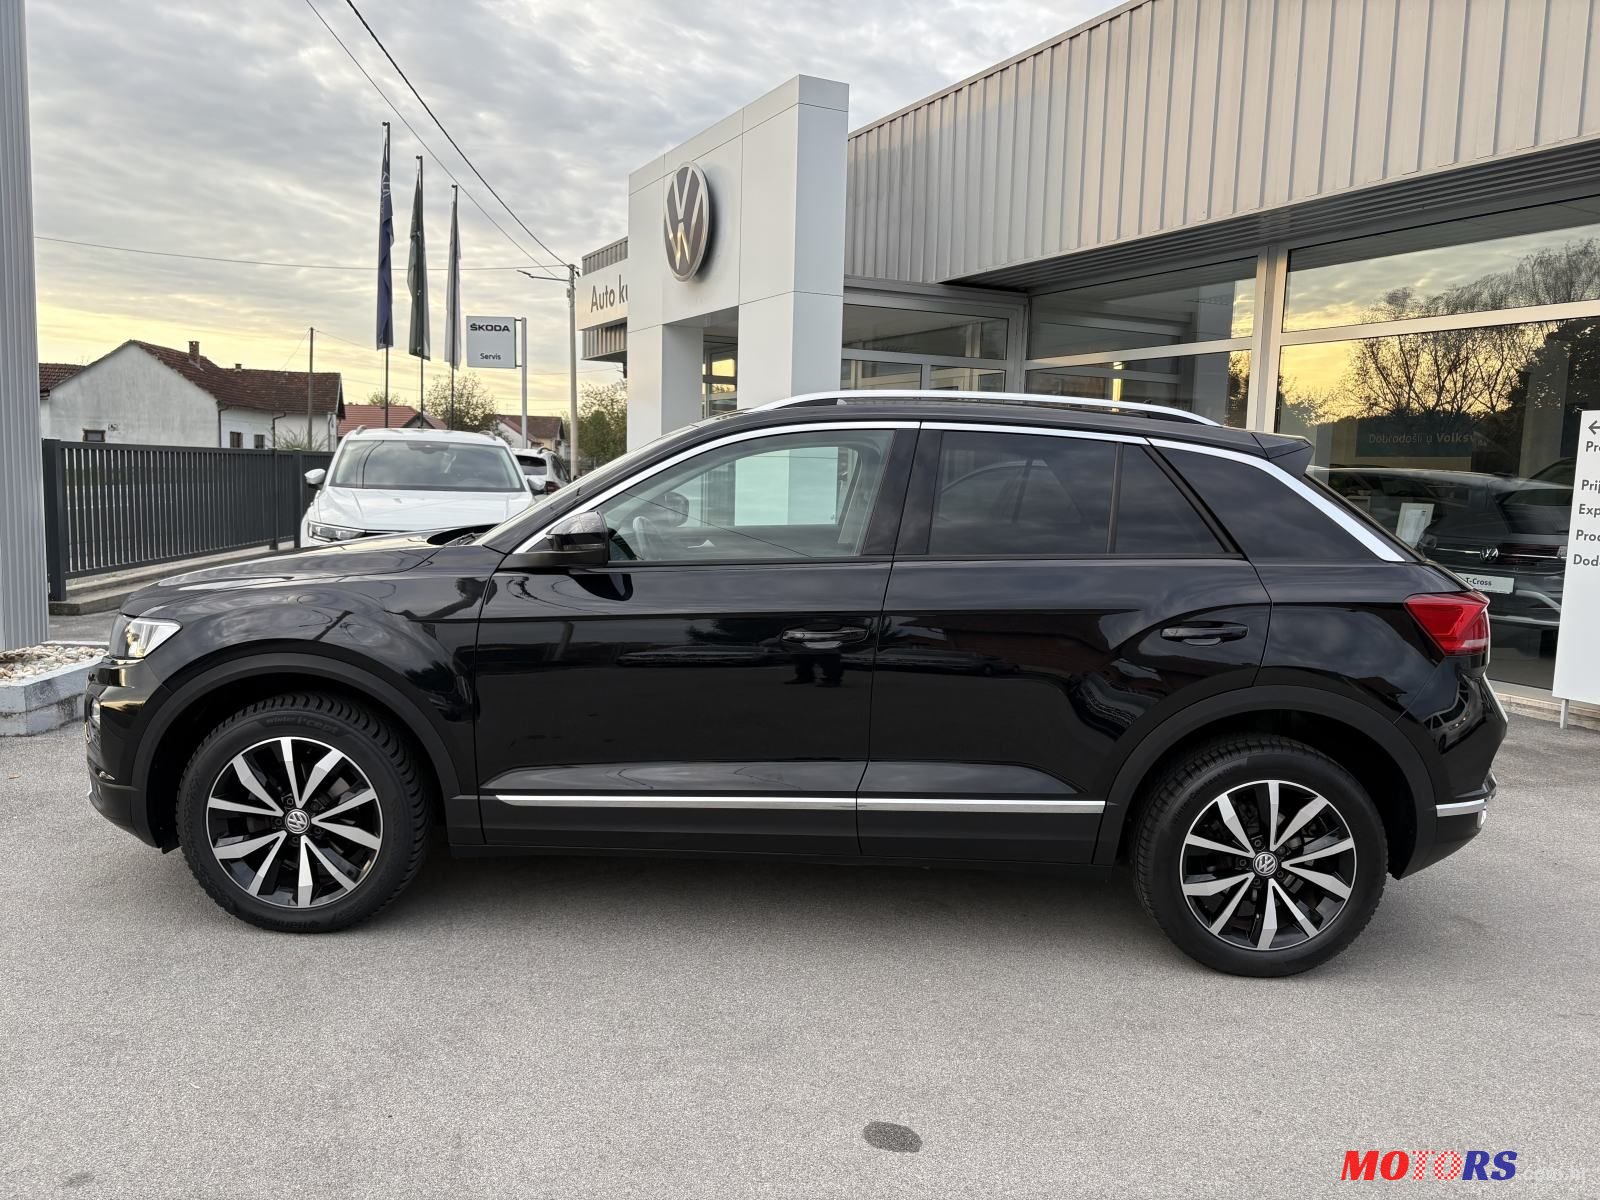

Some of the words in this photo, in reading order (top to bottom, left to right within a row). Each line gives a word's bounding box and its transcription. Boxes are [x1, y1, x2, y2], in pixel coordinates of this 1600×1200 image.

[590, 285, 615, 313] Auto
[470, 323, 510, 332] ŠKODA
[480, 352, 501, 360] Servis
[1586, 441, 1600, 452] Pr
[1573, 553, 1600, 567] Dod
[1465, 578, 1492, 586] T-Cross
